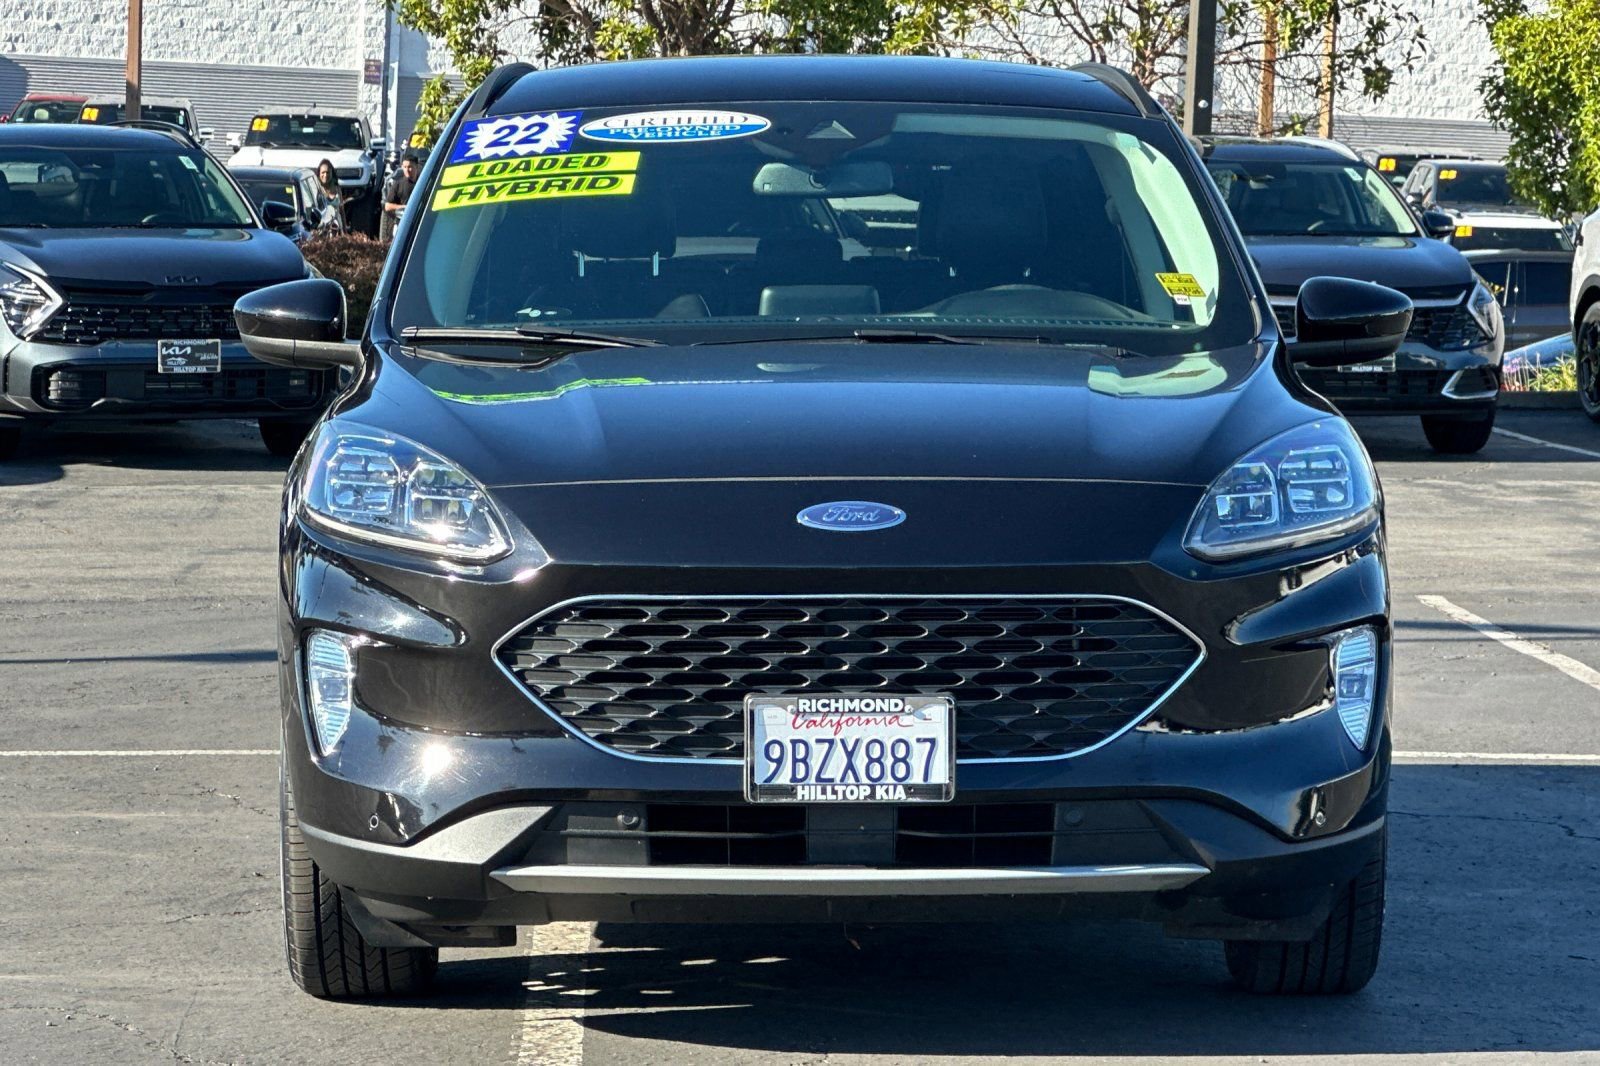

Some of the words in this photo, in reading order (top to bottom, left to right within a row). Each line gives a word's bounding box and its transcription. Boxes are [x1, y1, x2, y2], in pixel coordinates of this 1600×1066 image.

[603, 115, 749, 128] CERTIFIED
[609, 124, 741, 135] PRE-OWNED
[484, 122, 550, 149] 22
[629, 130, 721, 139] VEHICLE
[466, 154, 611, 180] LOADED
[448, 175, 623, 204] HYBRID
[162, 346, 191, 354] KIA
[822, 506, 881, 522] Ford
[798, 698, 904, 713] RICHMOND
[792, 712, 914, 736] California
[763, 737, 937, 784] 9BZX887
[797, 785, 871, 801] HILLTOP
[875, 785, 906, 801] KIA
